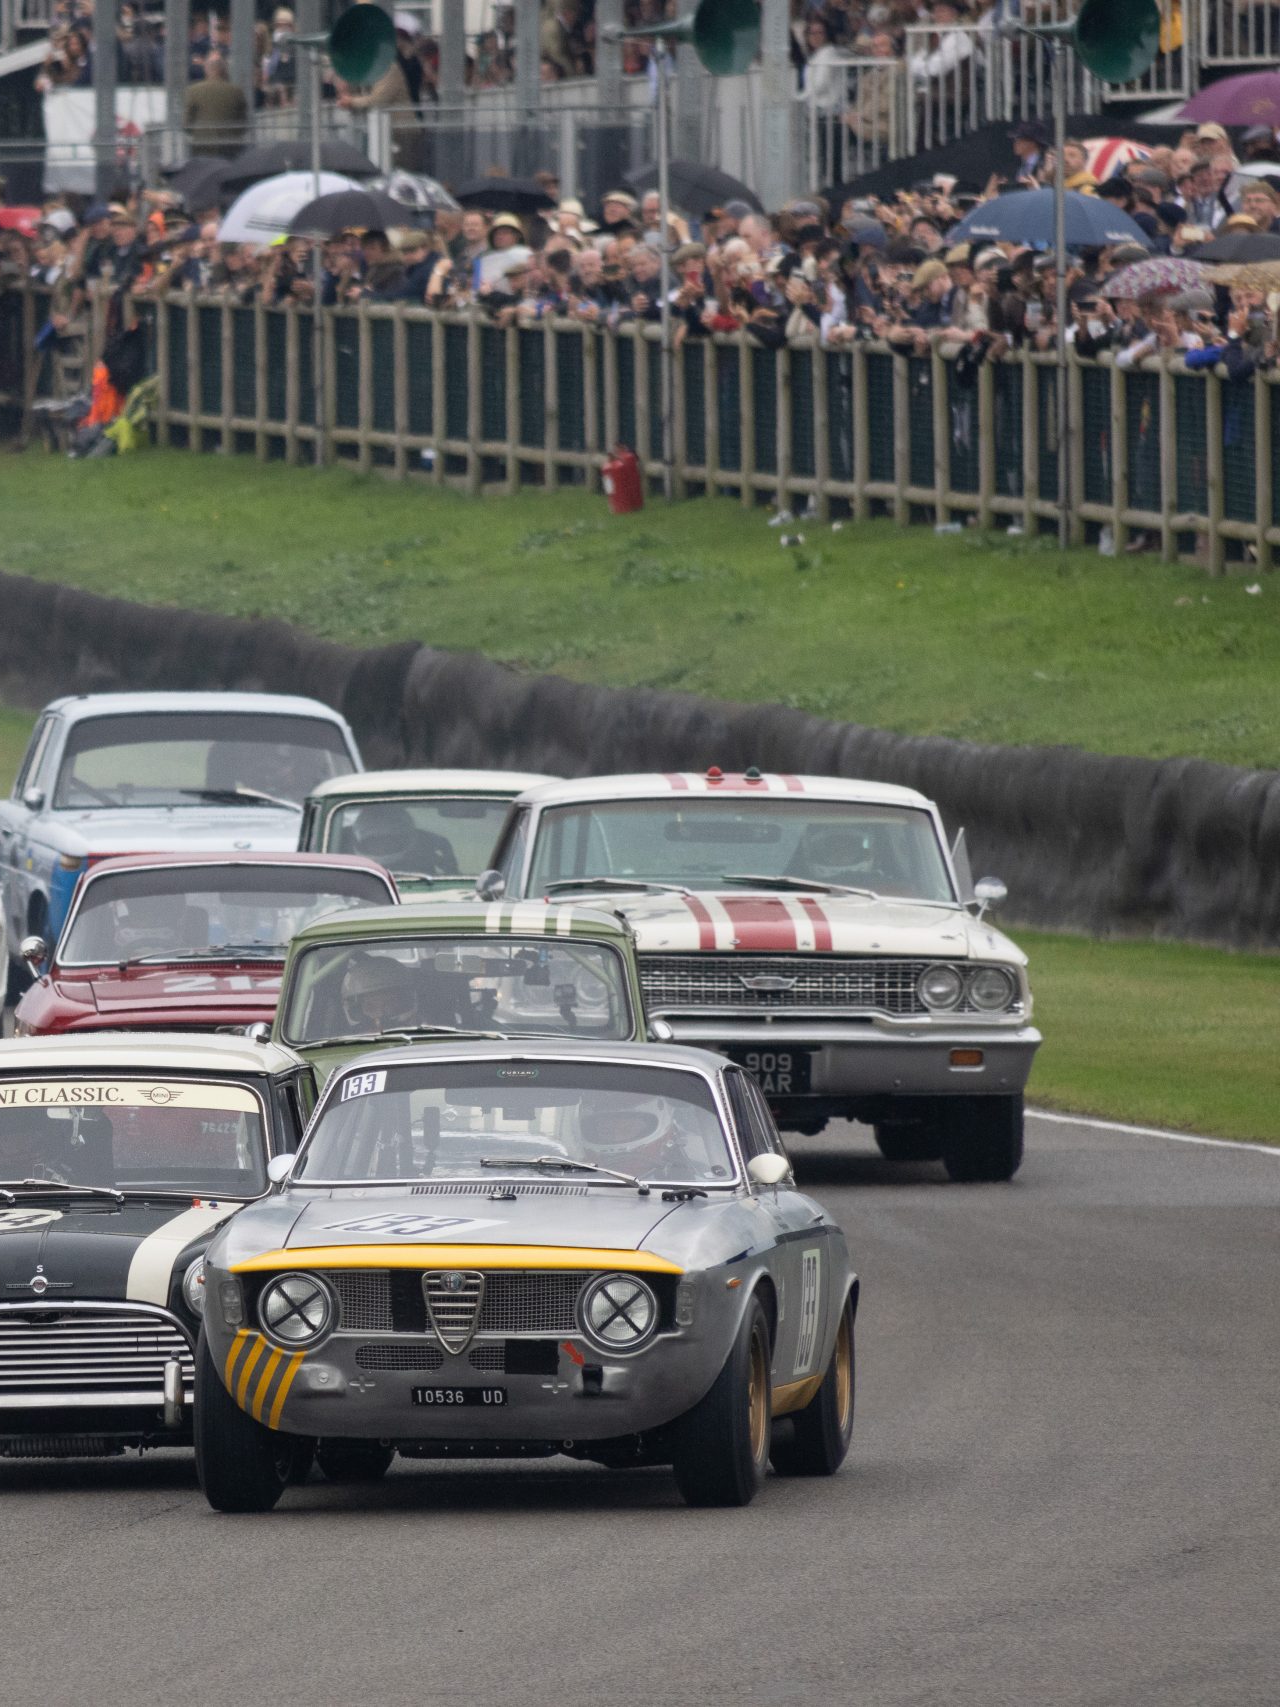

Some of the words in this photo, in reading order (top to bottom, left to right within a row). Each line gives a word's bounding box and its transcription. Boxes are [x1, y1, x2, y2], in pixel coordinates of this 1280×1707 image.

[745, 1053, 792, 1072] 909
[343, 1073, 377, 1100] 133
[753, 1073, 792, 1093] AR
[24, 1087, 125, 1104] CLASSIC.
[322, 1212, 476, 1236] 133
[36, 1264, 44, 1273] S
[795, 1255, 817, 1369] 133
[417, 1390, 464, 1404] 10536
[482, 1390, 503, 1404] UD
